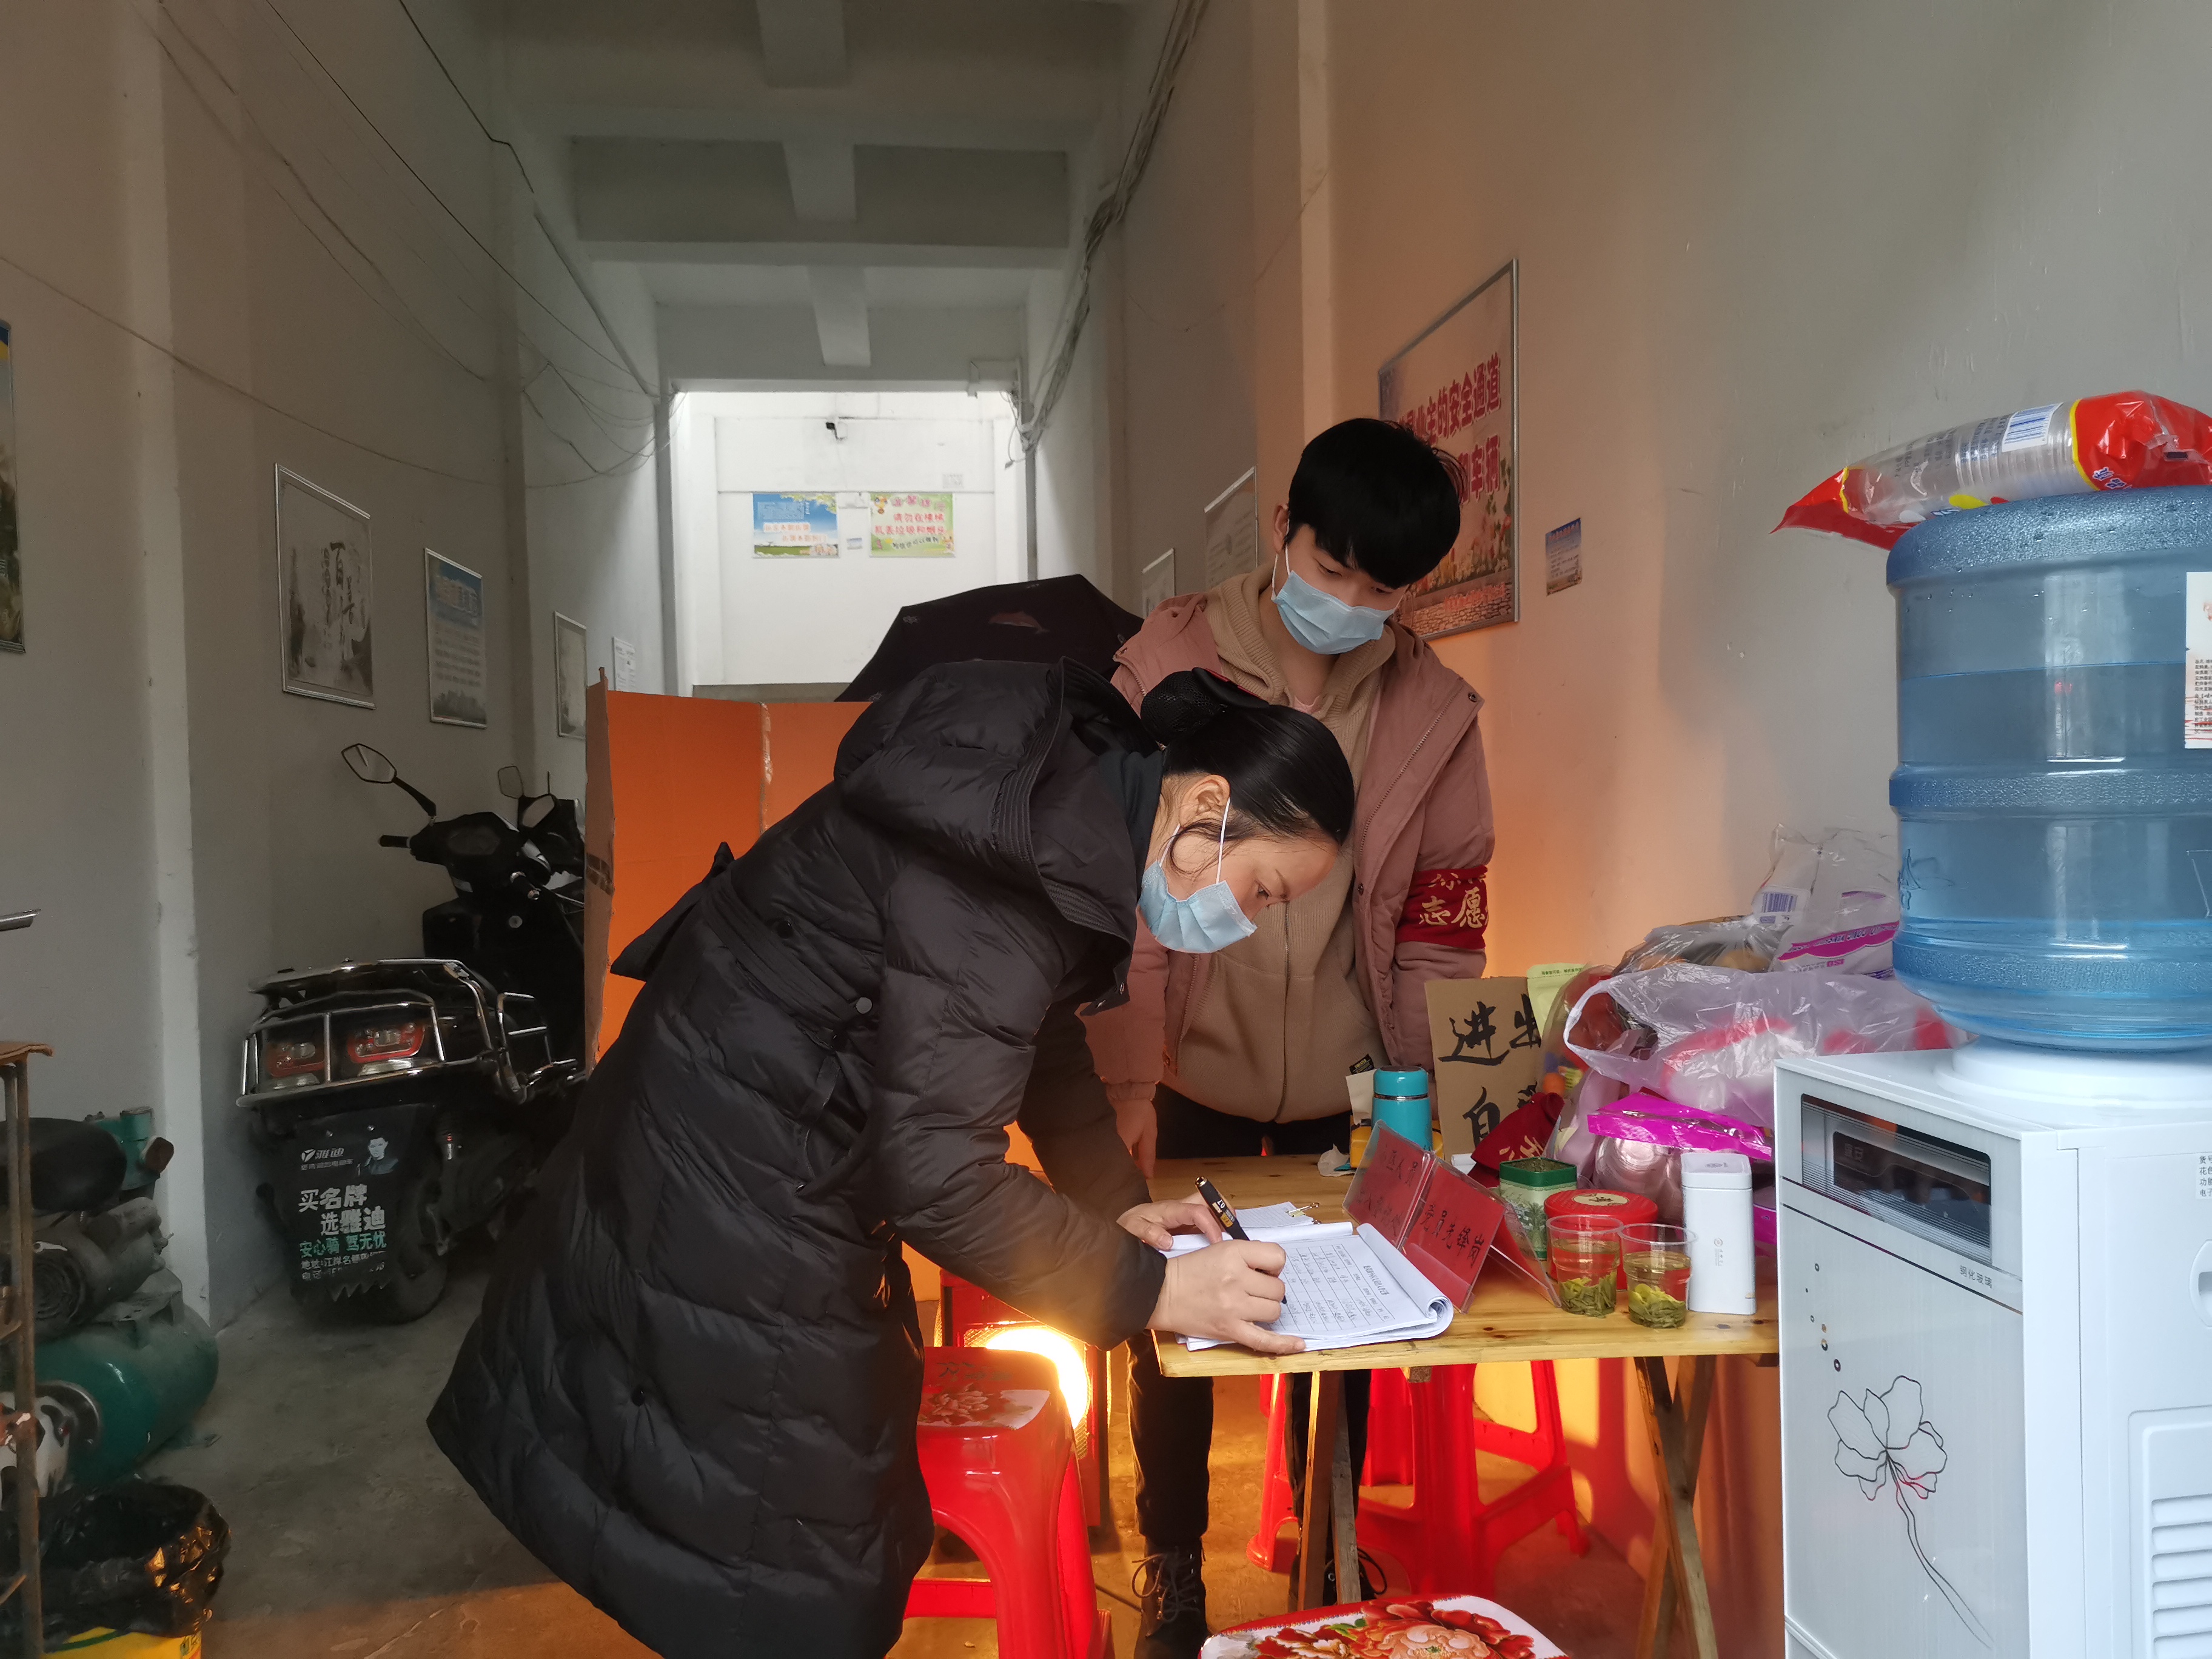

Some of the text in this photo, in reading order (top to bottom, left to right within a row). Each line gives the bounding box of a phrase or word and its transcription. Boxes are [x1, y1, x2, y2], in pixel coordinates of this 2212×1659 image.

[1399, 352, 1501, 446] 是业主的安全通道
[1419, 886, 1489, 928] 志愿
[1463, 1081, 1537, 1148] 自
[315, 1147, 344, 1159] 雅迪
[298, 1184, 367, 1212] 买名牌
[321, 1205, 386, 1236] 选雅迪
[1419, 1204, 1484, 1268] 党员先锋岗
[299, 1237, 340, 1258] 安心骑
[1959, 1265, 1992, 1289] 钢化玻璃
